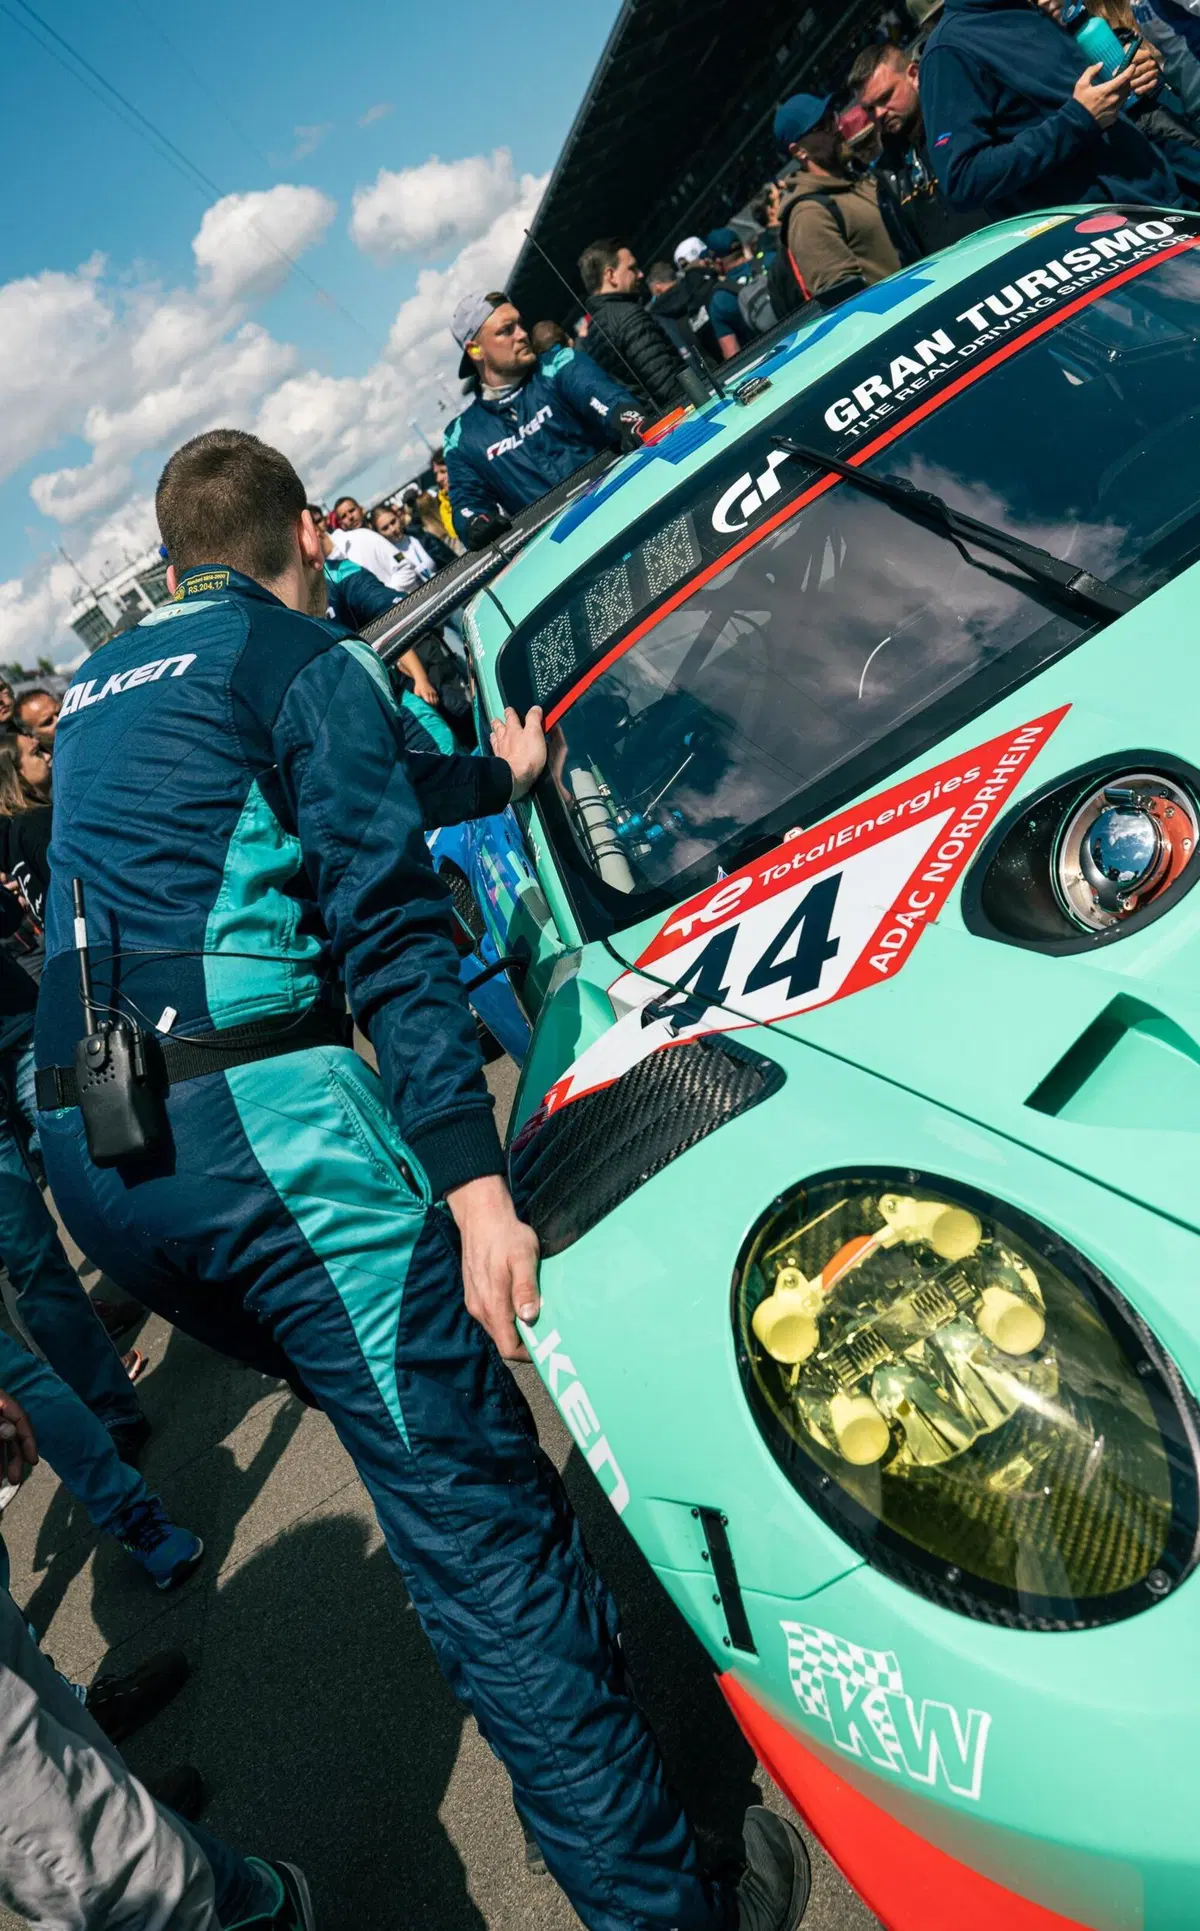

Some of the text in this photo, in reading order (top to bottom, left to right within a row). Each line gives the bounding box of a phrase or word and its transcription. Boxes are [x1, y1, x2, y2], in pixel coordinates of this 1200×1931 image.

[824, 328, 956, 432] GRAN
[844, 233, 1195, 436] THE REAL DRIVING SIMULATOR
[486, 405, 553, 461] FALKEN
[58, 653, 198, 722] ALKEN
[758, 766, 982, 886] TotalEnergies
[869, 727, 1045, 973] ADAC NORDRHEIN
[641, 871, 843, 1037] 44
[819, 1670, 992, 1800] KW
